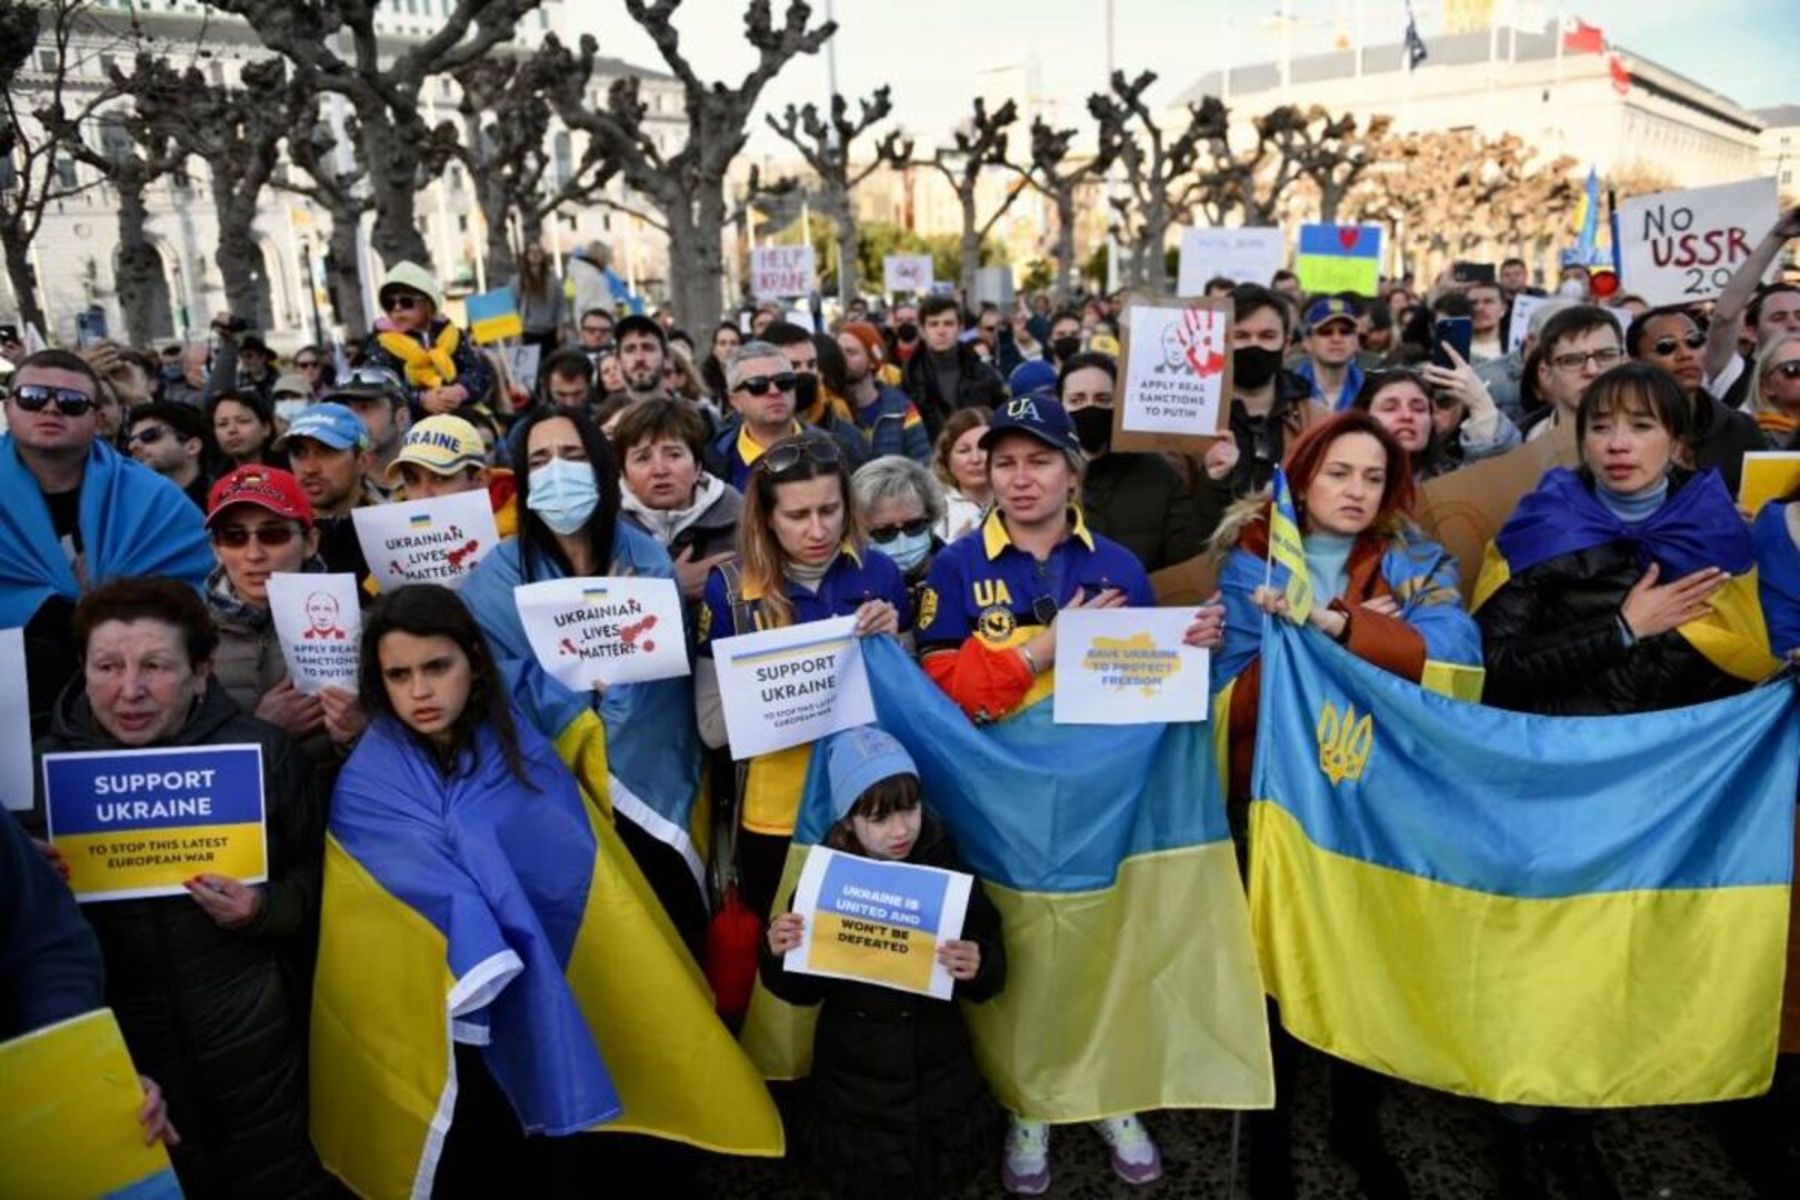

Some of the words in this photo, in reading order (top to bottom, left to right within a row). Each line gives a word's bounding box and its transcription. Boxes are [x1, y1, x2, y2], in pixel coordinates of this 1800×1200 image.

[1643, 204, 1693, 240] NO
[1652, 227, 1753, 267] USSR
[760, 250, 804, 268] HELP
[1684, 267, 1733, 294] 2.0
[1140, 380, 1175, 391] APPLY
[1178, 382, 1205, 392] REAL
[1139, 392, 1205, 405] SANCTIONS
[1007, 397, 1044, 423] UA
[1145, 406, 1161, 416] TO
[1163, 408, 1197, 418] PUTIN
[385, 529, 463, 550] UKRAINIAN
[409, 549, 448, 564] LIVES
[973, 579, 1014, 607] UA
[553, 602, 642, 628] UKRAINIAN
[582, 624, 620, 640] LIVES
[293, 644, 327, 654] APPLY
[303, 667, 318, 677] TO
[320, 667, 354, 677] PUTIN
[756, 655, 836, 682] SUPPORT
[1092, 662, 1109, 672] TO
[1112, 662, 1174, 672] PROTECT
[761, 675, 836, 702] UKRAINE
[1101, 675, 1162, 685] FREEDOM
[94, 770, 216, 795] SUPPORT
[96, 797, 213, 822] UKRAINE
[88, 844, 107, 856] TO
[110, 841, 146, 854] STOP
[149, 838, 179, 851] THIS
[182, 836, 229, 849] LATEST
[107, 852, 182, 869] EUROPEAN
[183, 851, 215, 862] WAR
[842, 885, 903, 906] UKRAINE
[905, 898, 919, 911] IS
[836, 898, 888, 918] UNITED
[890, 911, 921, 925] AND
[841, 918, 888, 936] WON'T
[891, 928, 910, 940] BE
[837, 932, 910, 954] DEFEATED
